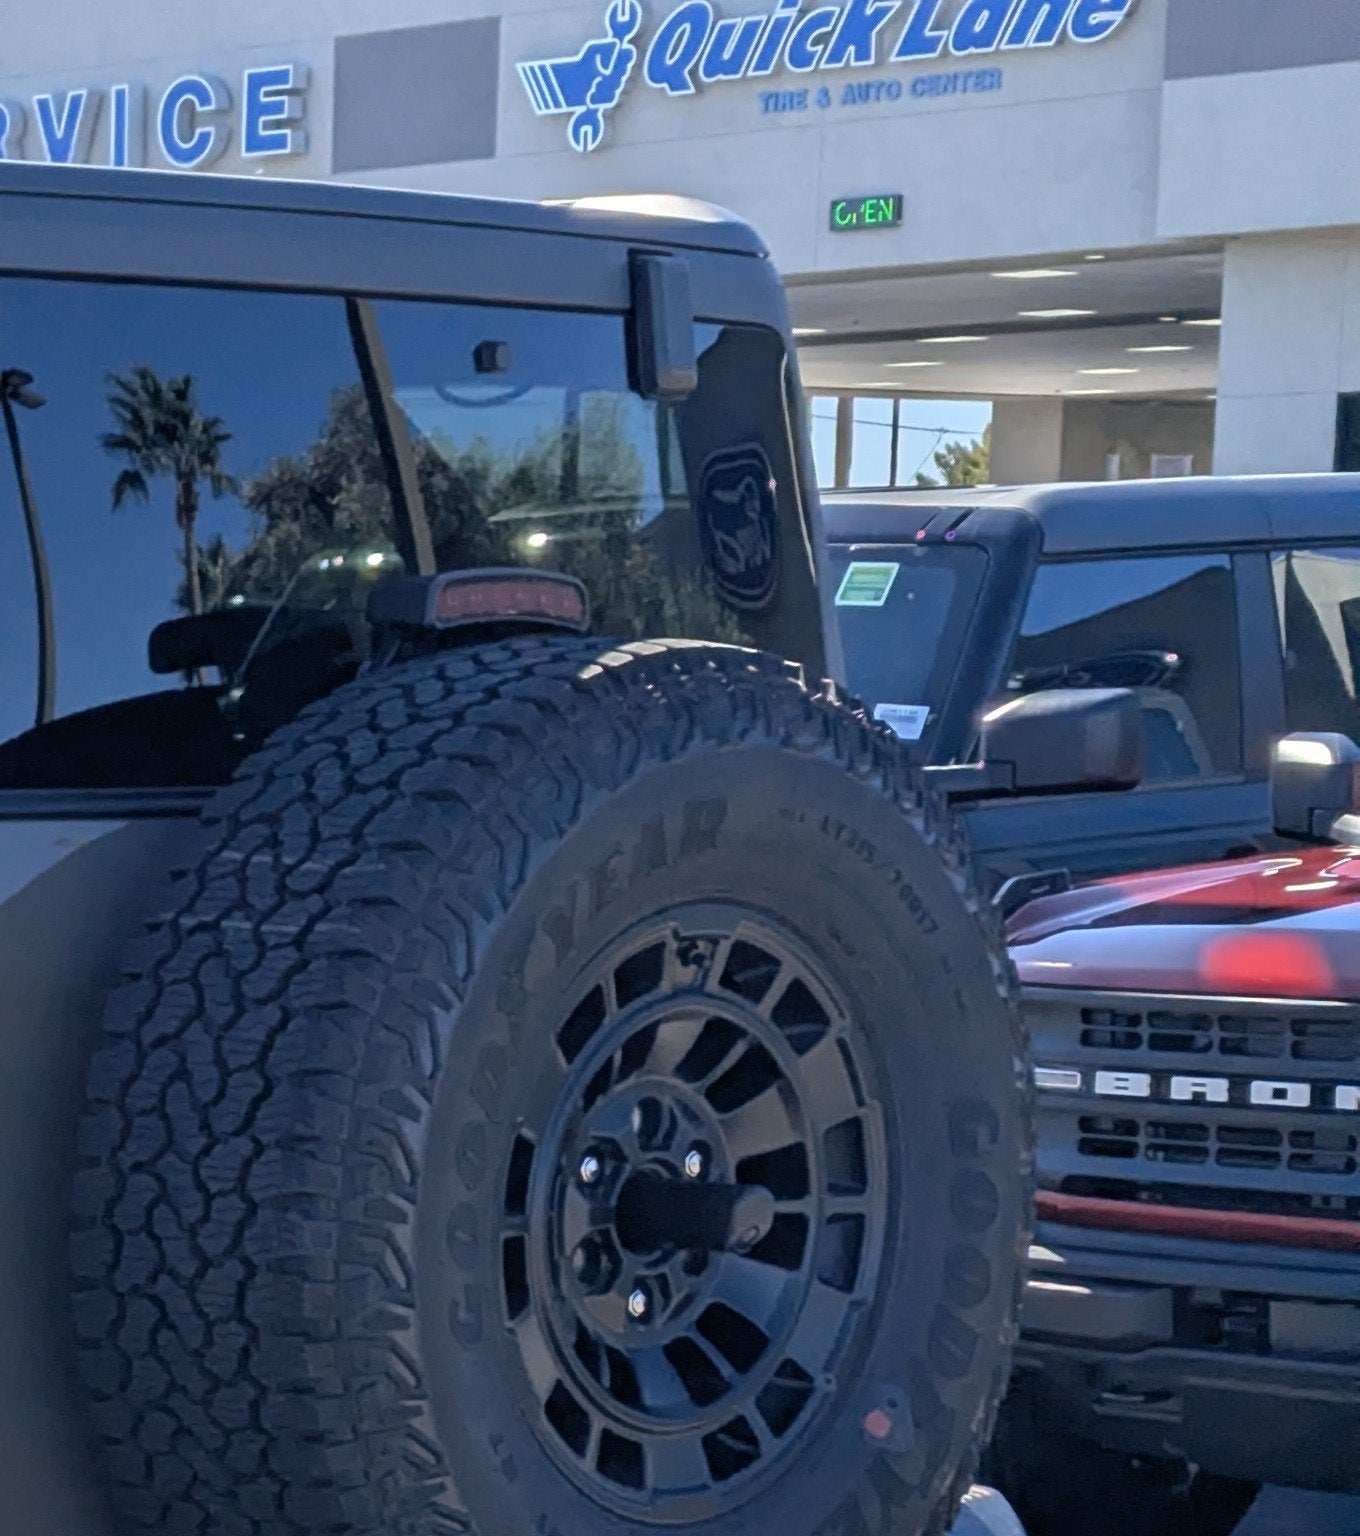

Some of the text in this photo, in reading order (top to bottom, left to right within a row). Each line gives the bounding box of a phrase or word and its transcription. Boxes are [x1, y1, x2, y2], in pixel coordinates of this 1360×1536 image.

[643, 0, 1134, 96] Quick Lane
[758, 87, 809, 115] TIRE
[839, 78, 902, 106] AUTO
[909, 66, 1003, 98] CENTER
